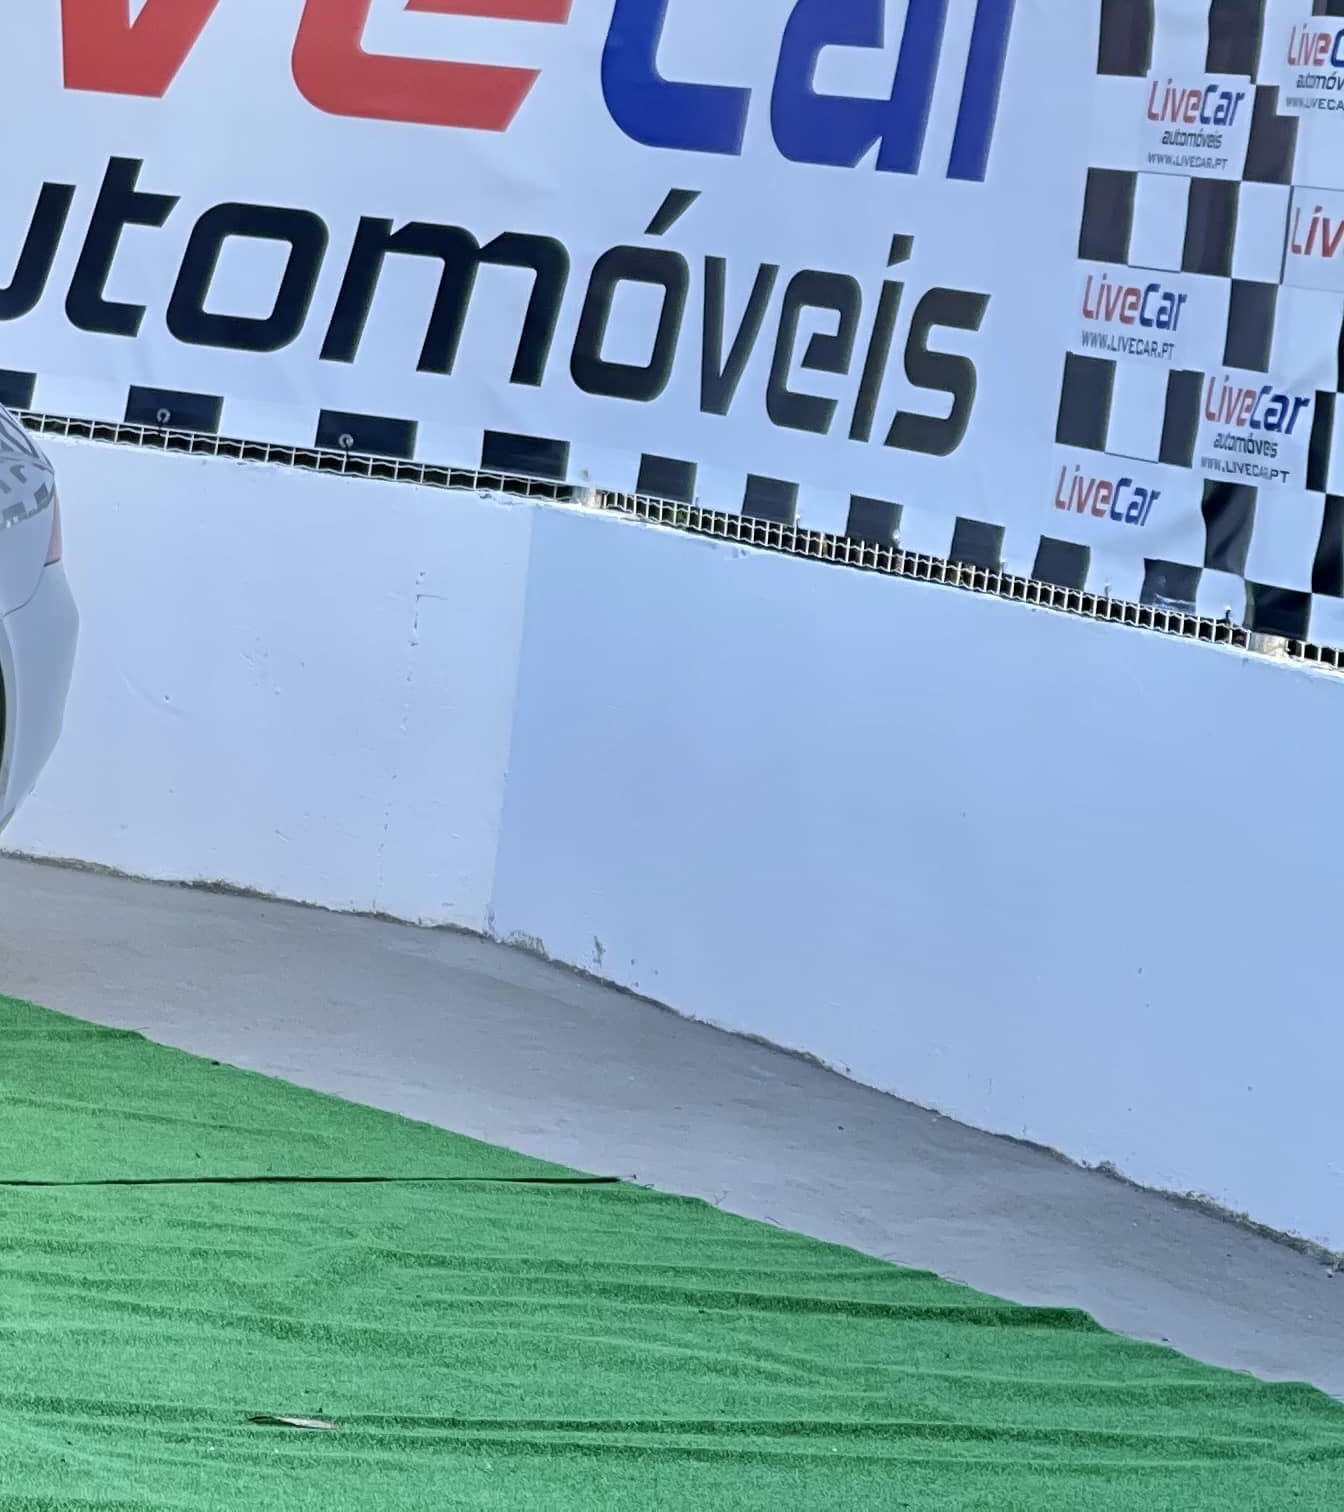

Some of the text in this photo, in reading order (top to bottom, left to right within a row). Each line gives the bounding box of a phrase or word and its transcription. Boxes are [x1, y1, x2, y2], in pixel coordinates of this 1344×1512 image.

[1147, 78, 1246, 127] LiveCar
[1082, 273, 1188, 331] LiveCar
[1081, 329, 1175, 360] WWW.LIVECAR.PT
[1205, 374, 1311, 435] LiveCar
[1054, 463, 1161, 527] LiveCar
